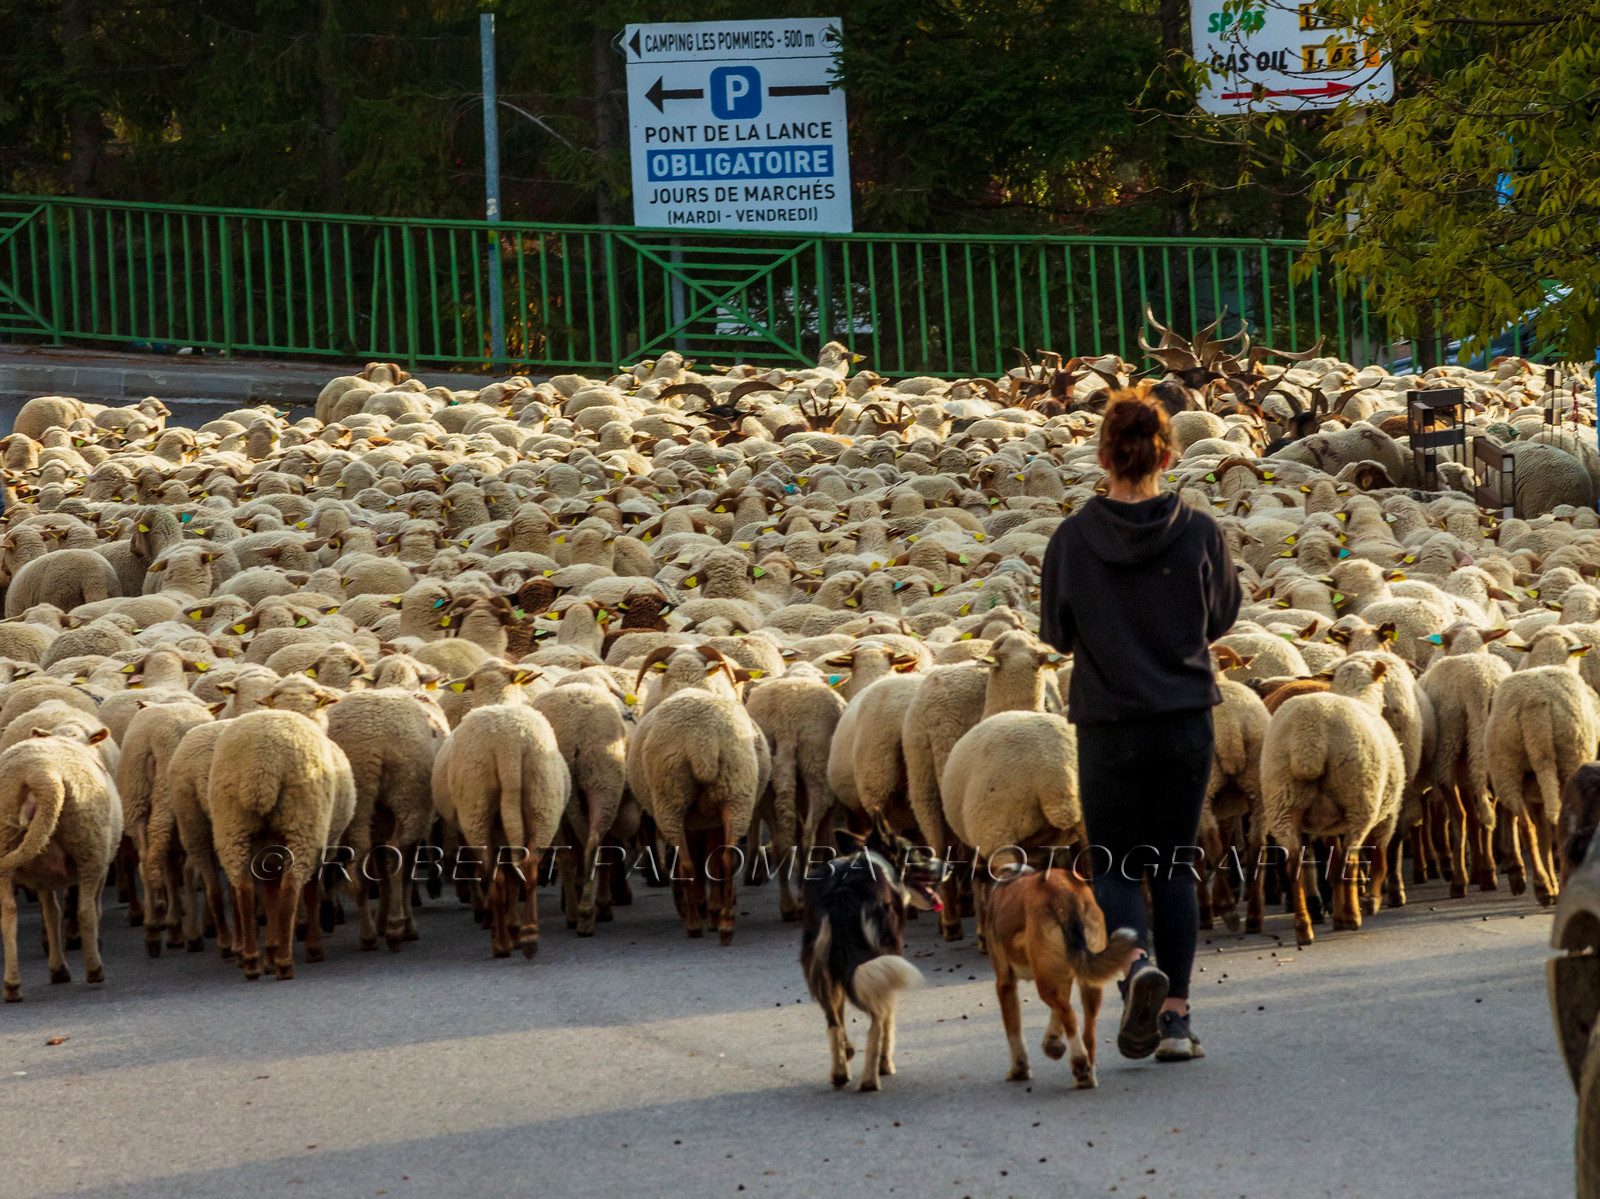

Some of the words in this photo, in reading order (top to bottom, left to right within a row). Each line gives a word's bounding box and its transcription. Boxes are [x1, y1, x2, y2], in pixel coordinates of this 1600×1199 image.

[1207, 11, 1234, 34] SP
[645, 32, 694, 53] CAMPING
[695, 31, 716, 51] LES
[717, 29, 775, 50] POMMIERS
[784, 29, 802, 48] 500
[804, 33, 815, 48] m
[1210, 52, 1249, 75] GAS
[1256, 50, 1289, 72] OIL
[725, 74, 750, 111] P
[645, 125, 698, 144] PONT
[704, 124, 730, 142] DE
[735, 123, 760, 141] LA
[766, 121, 833, 140] LANCE
[652, 149, 830, 177] OBLIGATOIRE
[650, 186, 709, 205] JOURS
[715, 185, 738, 202] DE
[744, 179, 836, 202] MARCHÉS
[667, 209, 722, 225] (MARDI
[735, 206, 818, 223] VENDREDI)
